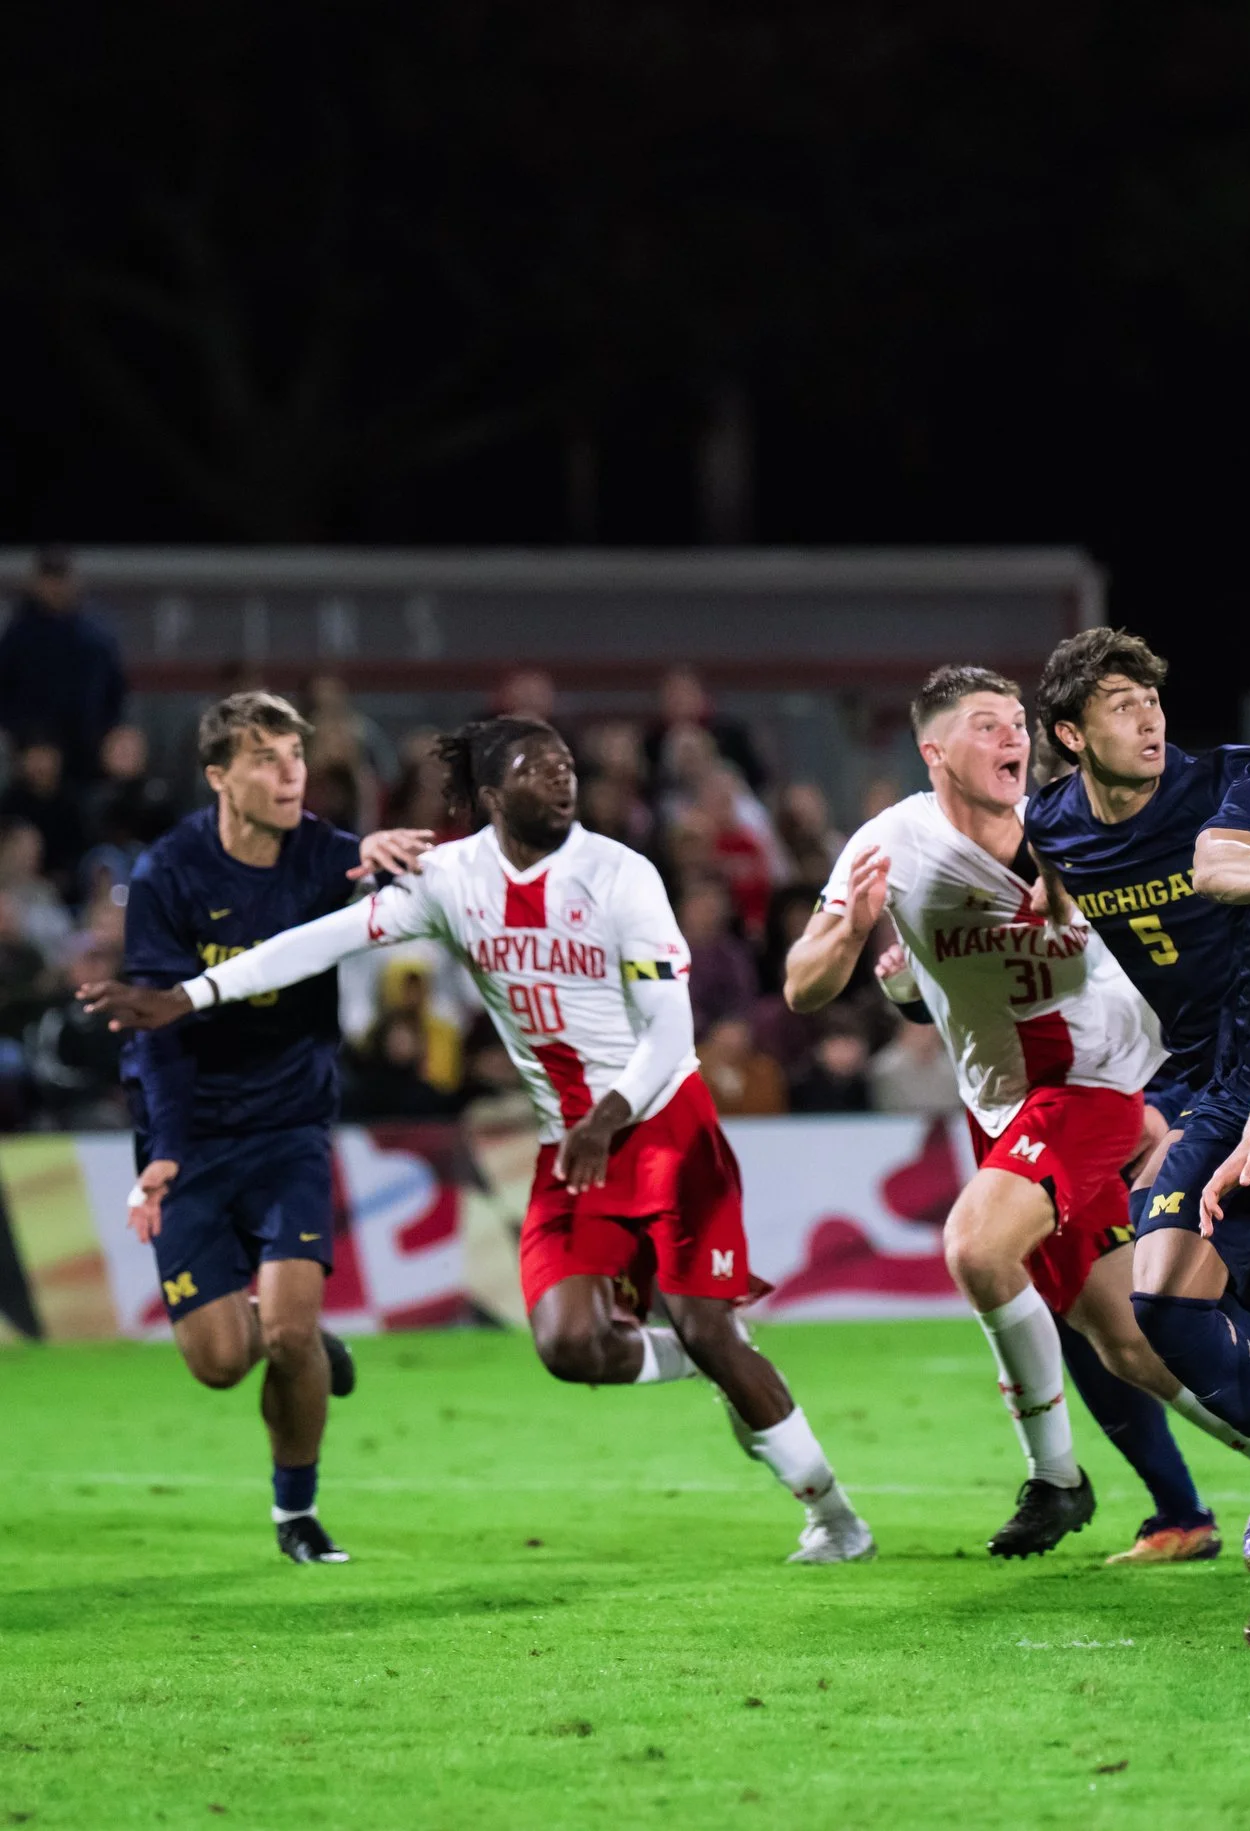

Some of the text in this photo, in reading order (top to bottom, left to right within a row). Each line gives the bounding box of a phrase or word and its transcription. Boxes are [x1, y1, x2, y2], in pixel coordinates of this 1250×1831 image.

[1077, 868, 1196, 918] MICHIGA
[934, 926, 1085, 962] MARYLAN
[1129, 914, 1179, 966] 5
[1004, 958, 1053, 1005] 31
[508, 982, 565, 1034] 90
[1010, 1134, 1046, 1164] M
[1149, 1191, 1185, 1219] M
[711, 1248, 734, 1279] M
[162, 1271, 199, 1306] M
